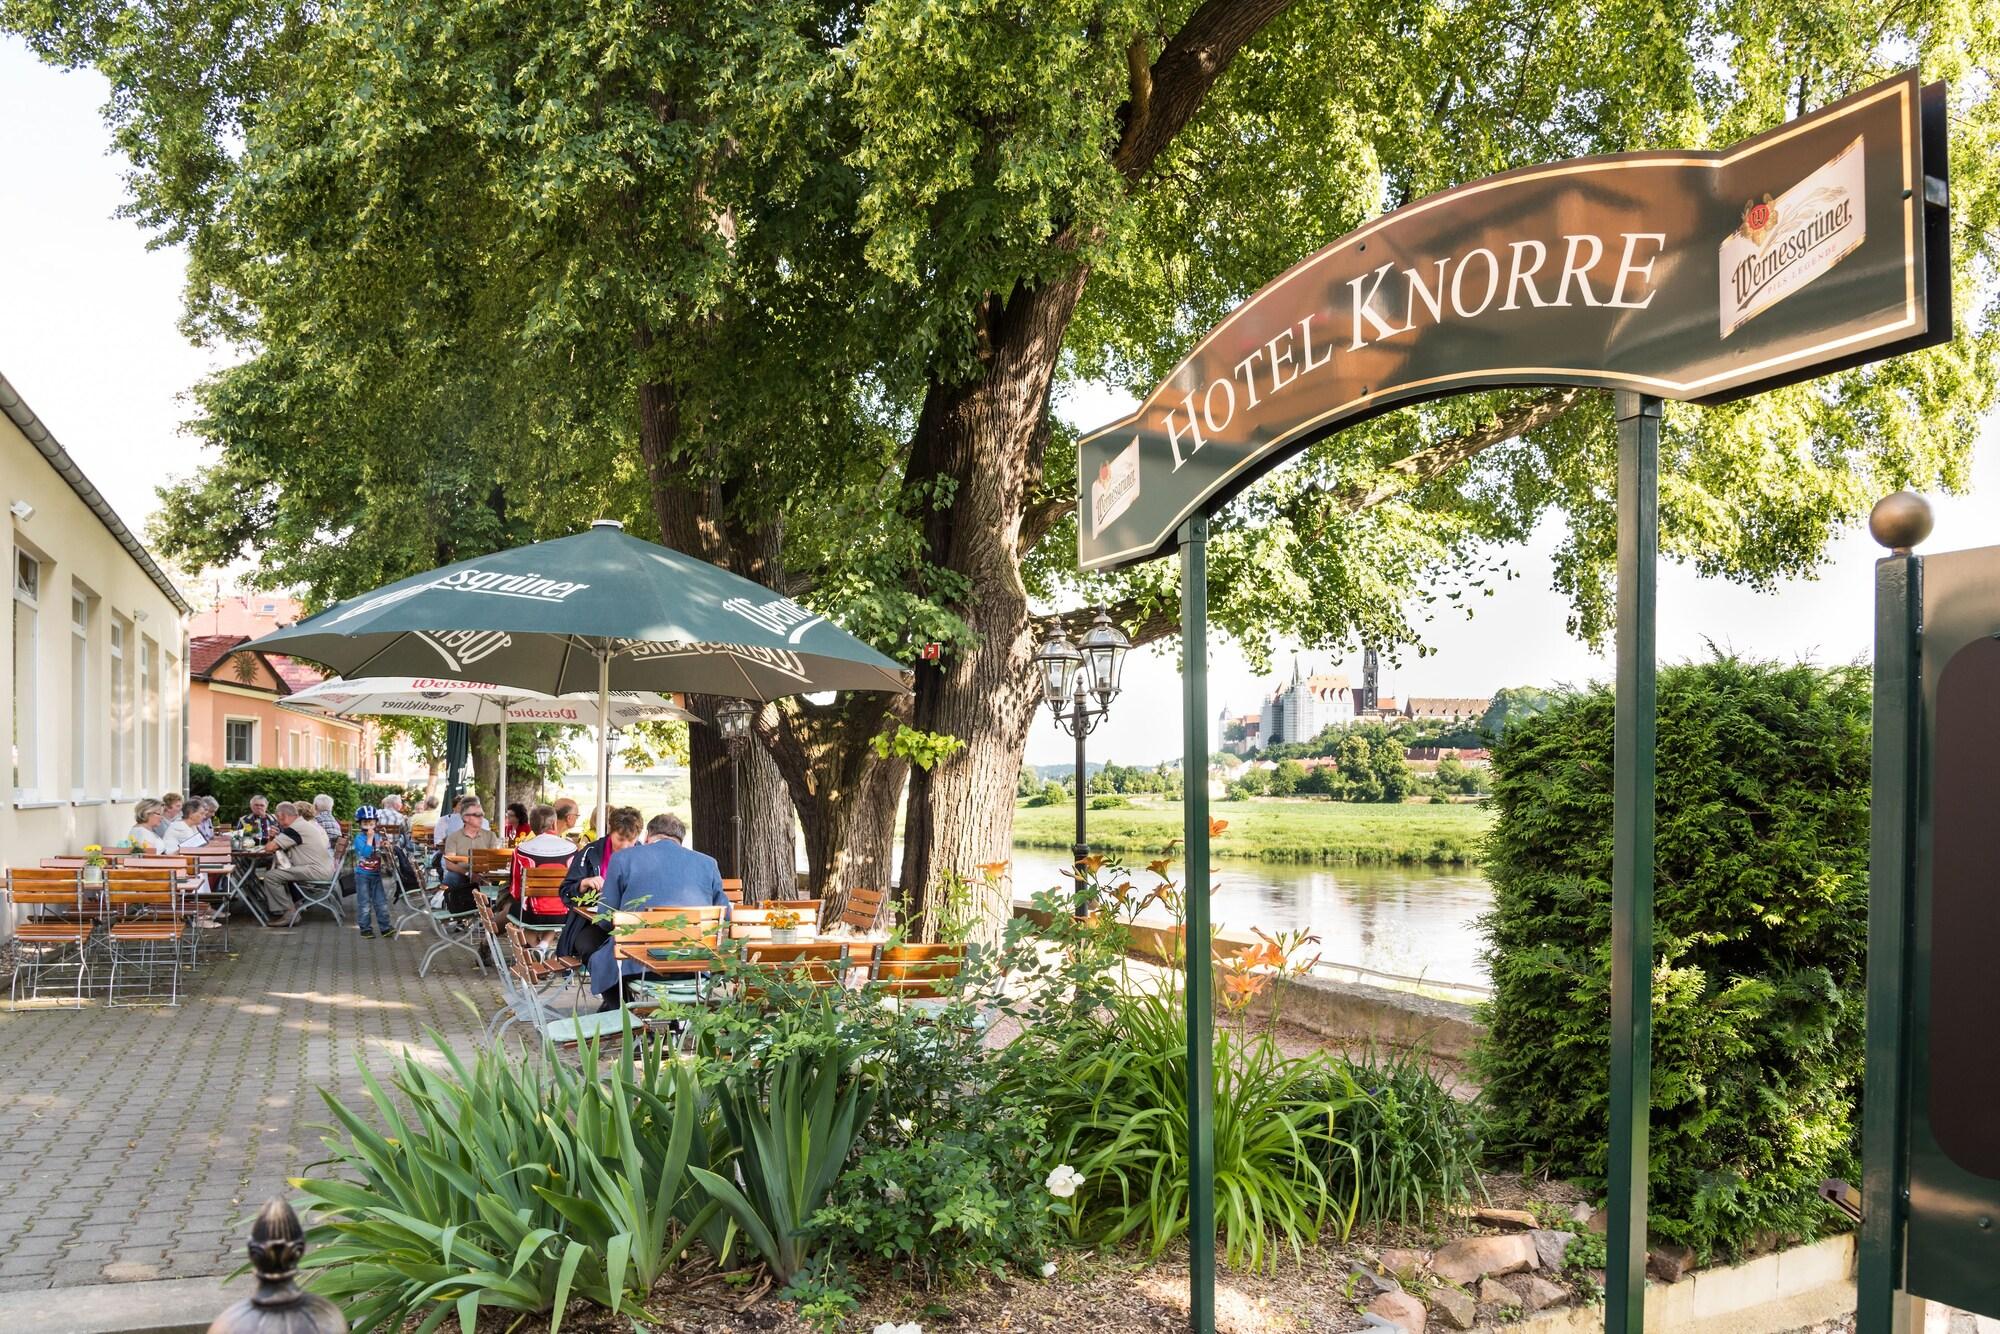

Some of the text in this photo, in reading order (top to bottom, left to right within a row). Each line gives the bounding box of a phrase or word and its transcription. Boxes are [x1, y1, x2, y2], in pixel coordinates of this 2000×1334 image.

[1731, 198, 1853, 306] Wernesgrüner
[1160, 233, 1666, 474] HOTEL KNORRE
